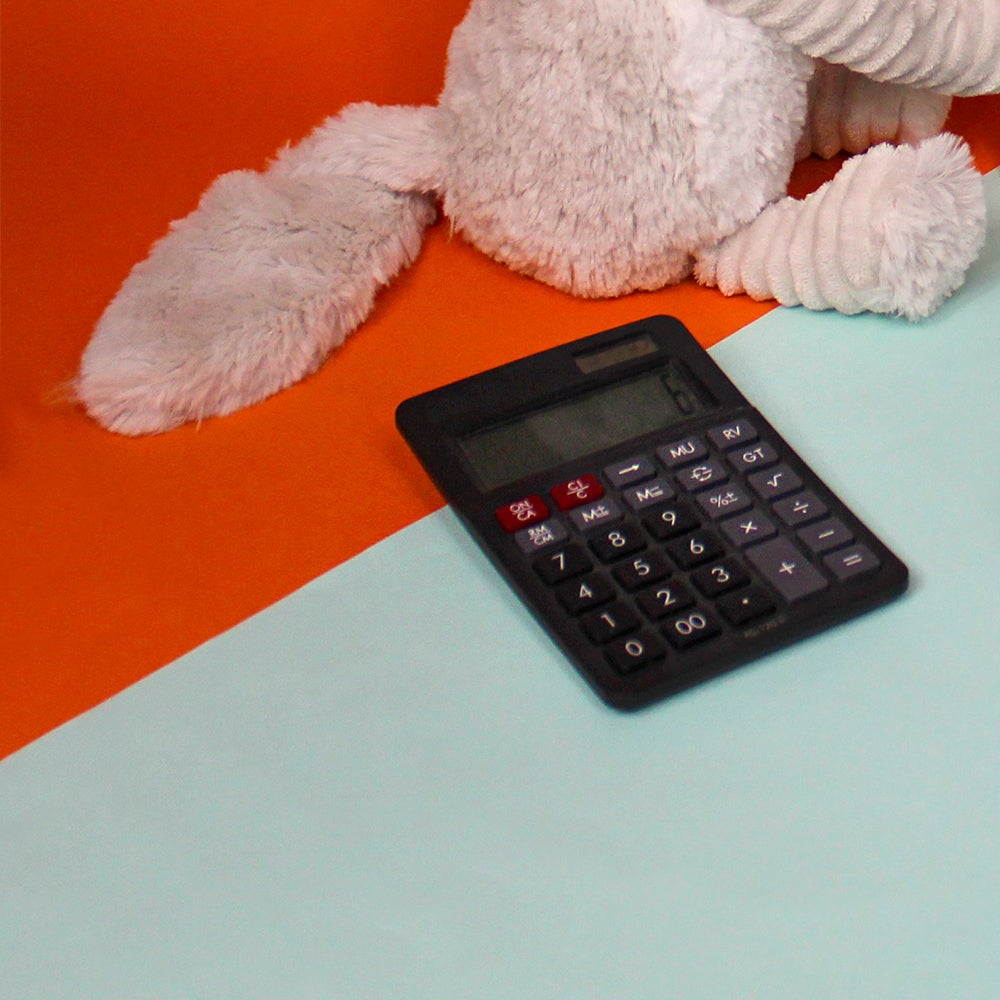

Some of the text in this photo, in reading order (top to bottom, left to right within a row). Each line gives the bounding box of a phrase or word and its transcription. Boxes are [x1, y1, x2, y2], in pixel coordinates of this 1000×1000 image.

[722, 425, 741, 440] RV
[670, 442, 695, 458] MU
[742, 448, 766, 462] GT
[510, 500, 533, 512] ON
[517, 510, 537, 521] CA
[662, 511, 676, 526] 9
[608, 532, 626, 547] 8
[690, 539, 704, 554] 6
[552, 553, 564, 570] 7
[633, 559, 650, 576] 5
[711, 567, 729, 582] 3
[579, 584, 592, 598] 4
[657, 589, 676, 606] 2
[601, 614, 615, 628] 1
[675, 615, 706, 635] 00
[625, 641, 642, 656] 0
